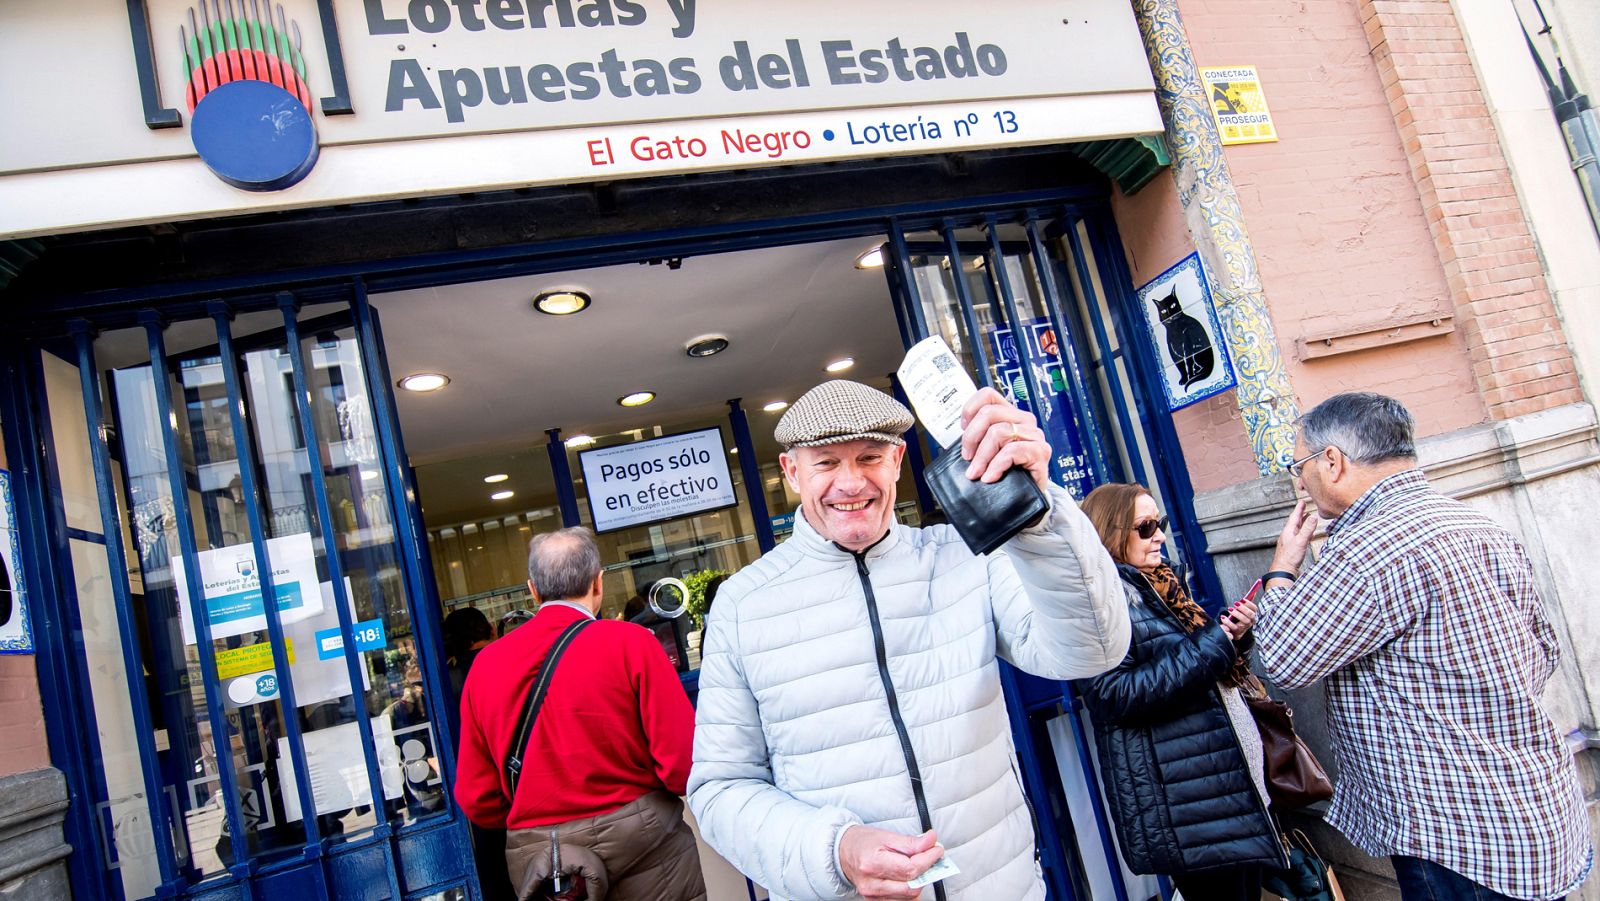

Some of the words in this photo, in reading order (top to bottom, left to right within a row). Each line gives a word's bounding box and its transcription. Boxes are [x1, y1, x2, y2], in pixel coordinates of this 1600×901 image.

[669, 0, 696, 38] y
[385, 48, 701, 123] Apuestas
[719, 38, 810, 92] del
[820, 31, 1008, 85] Estado
[1205, 70, 1254, 79] CONECTADA
[1219, 114, 1269, 125] PROSEGUR
[587, 137, 614, 165] El
[630, 136, 707, 161] Gato
[720, 129, 811, 158] Negro
[847, 116, 942, 145] Lotería
[954, 113, 979, 137] nº
[993, 111, 1019, 133] 13
[600, 458, 664, 482] Pagos
[668, 447, 711, 469] sólo
[1077, 455, 1084, 467] y
[606, 493, 631, 510] en
[637, 476, 719, 504] efectivo
[630, 502, 660, 512] Disculpen
[671, 494, 700, 504] molestias
[354, 628, 376, 643] +18
[258, 678, 275, 688] +18
